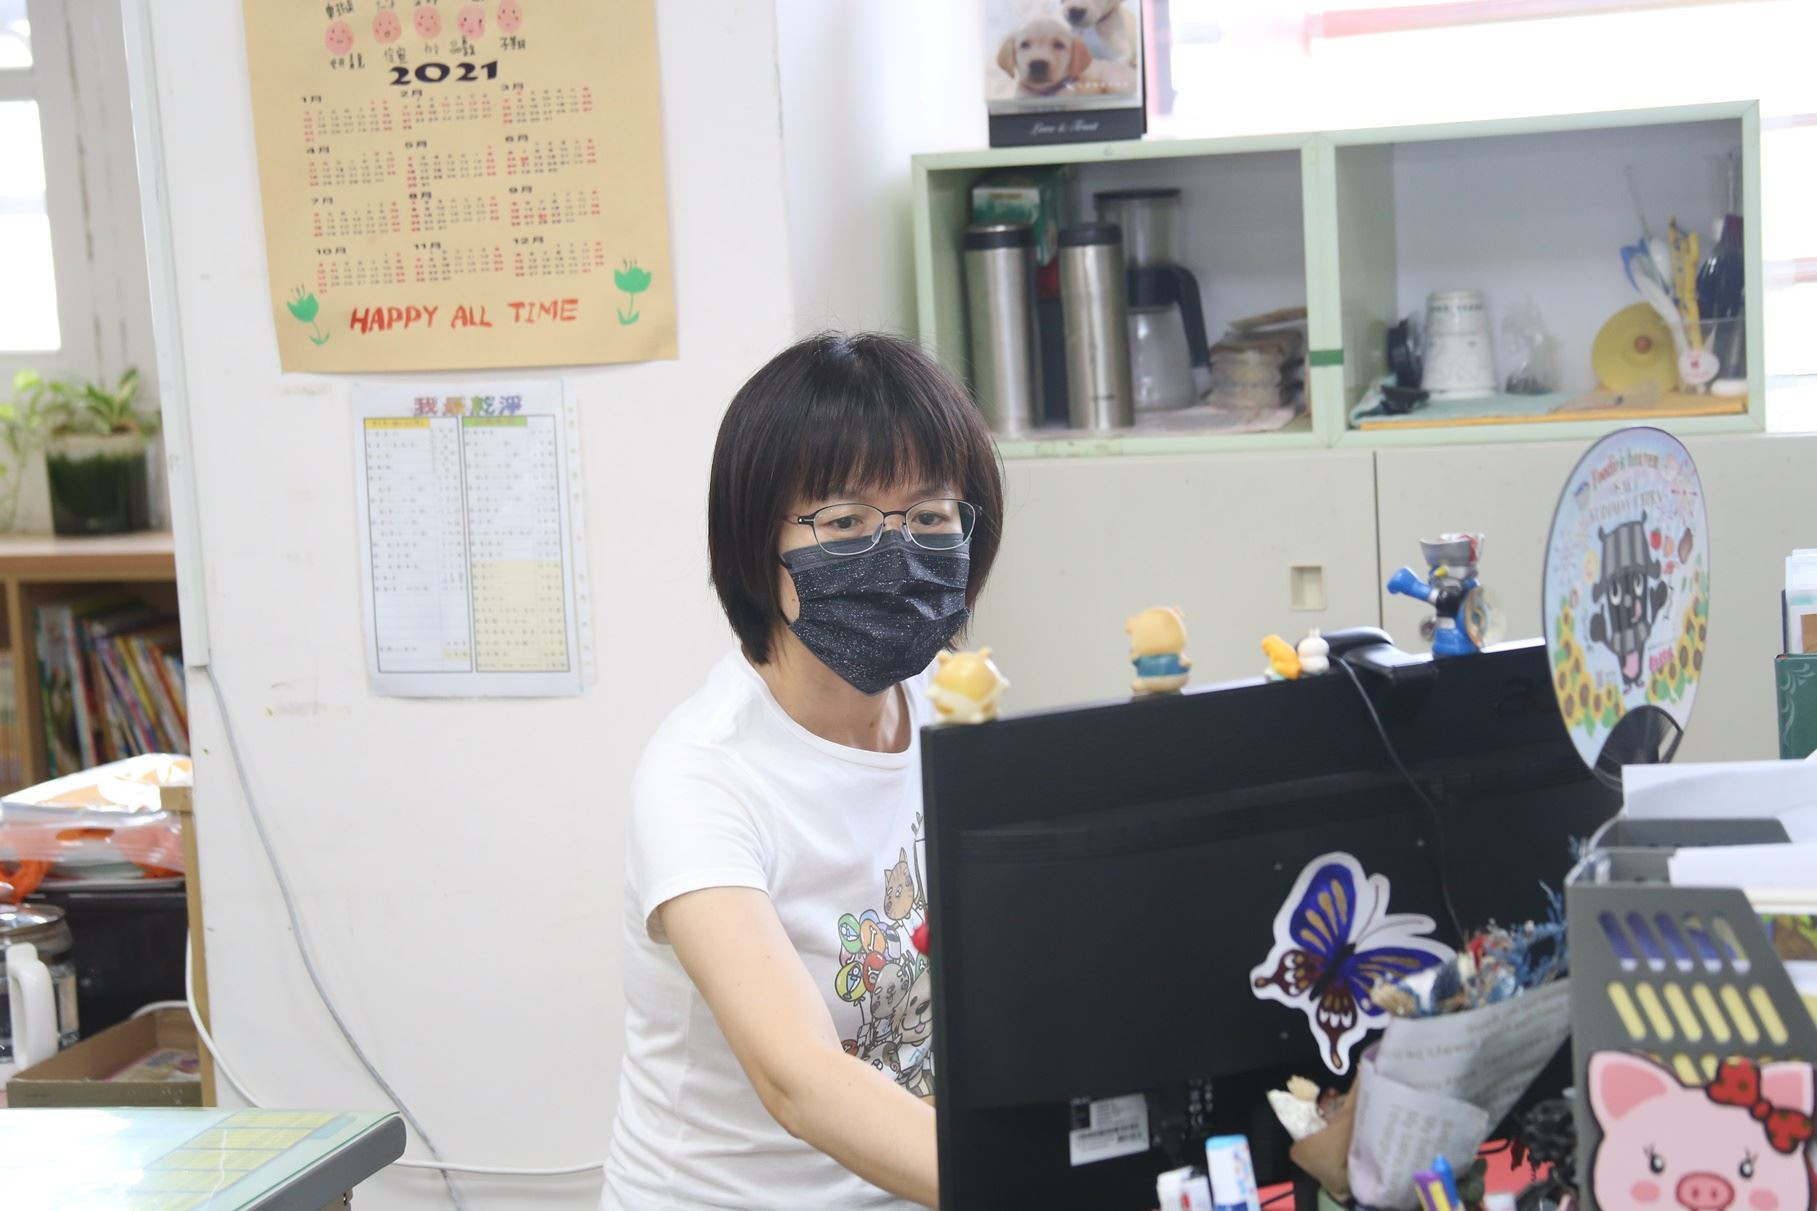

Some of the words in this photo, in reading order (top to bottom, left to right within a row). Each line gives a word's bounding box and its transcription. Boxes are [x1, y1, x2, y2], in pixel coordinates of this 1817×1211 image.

[389, 60, 498, 85] 2021
[350, 305, 438, 334] HAPPY
[451, 306, 492, 329] ALL
[507, 298, 579, 325] TIME
